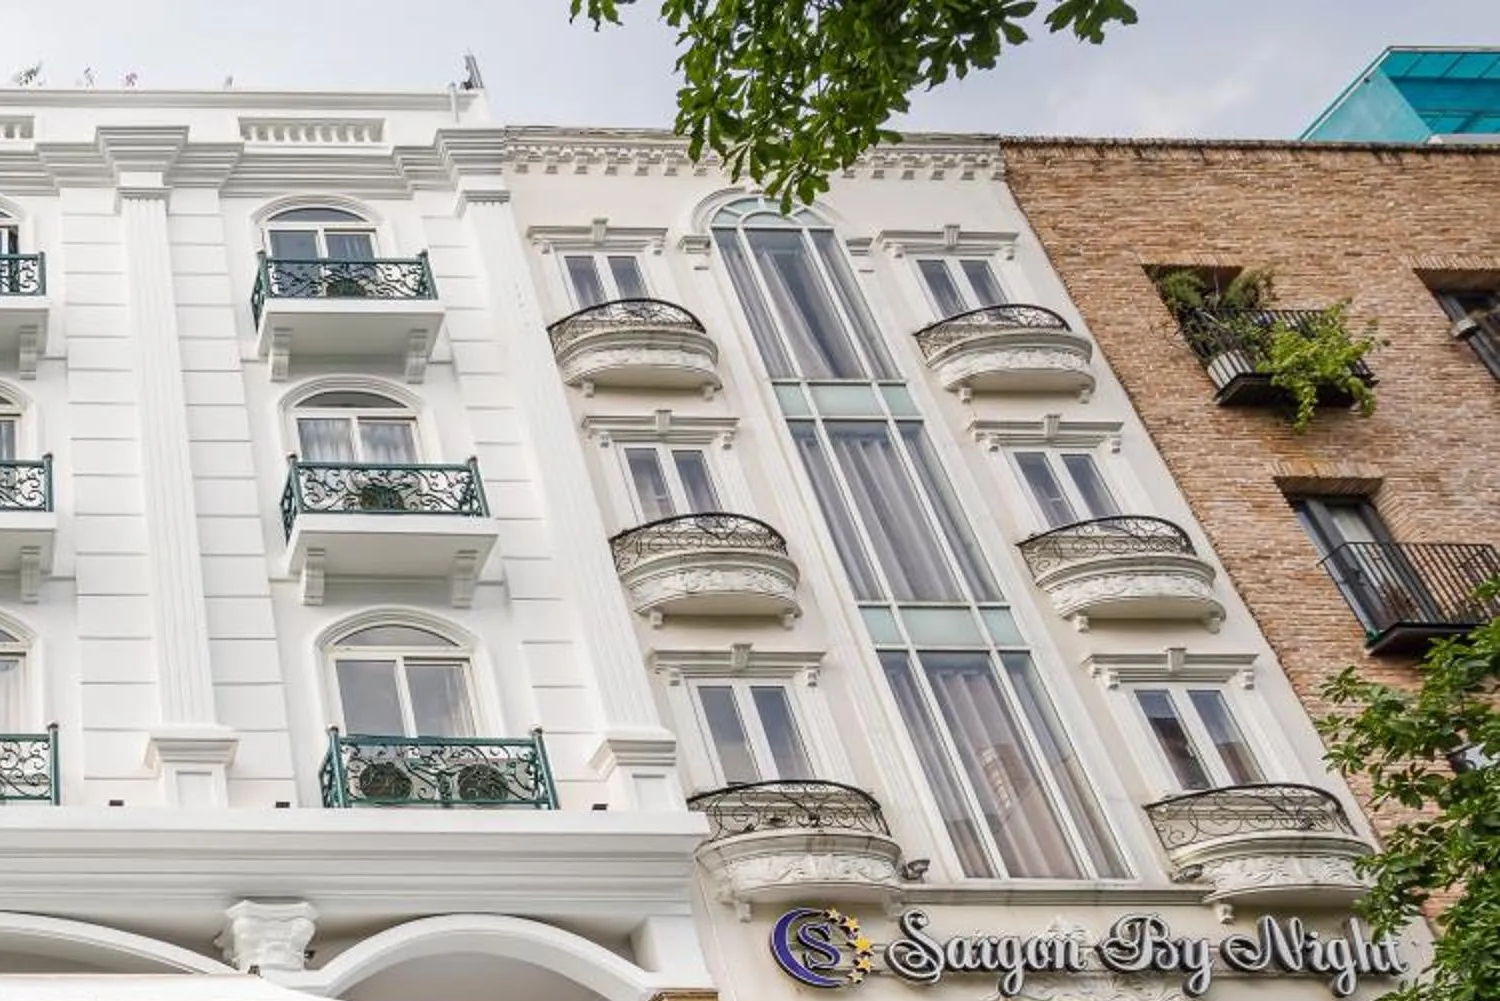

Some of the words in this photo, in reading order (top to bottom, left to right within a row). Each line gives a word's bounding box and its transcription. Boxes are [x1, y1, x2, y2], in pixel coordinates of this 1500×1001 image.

[884, 907, 1089, 998] Saigon
[1096, 911, 1213, 998] By
[1220, 914, 1409, 999] Night
